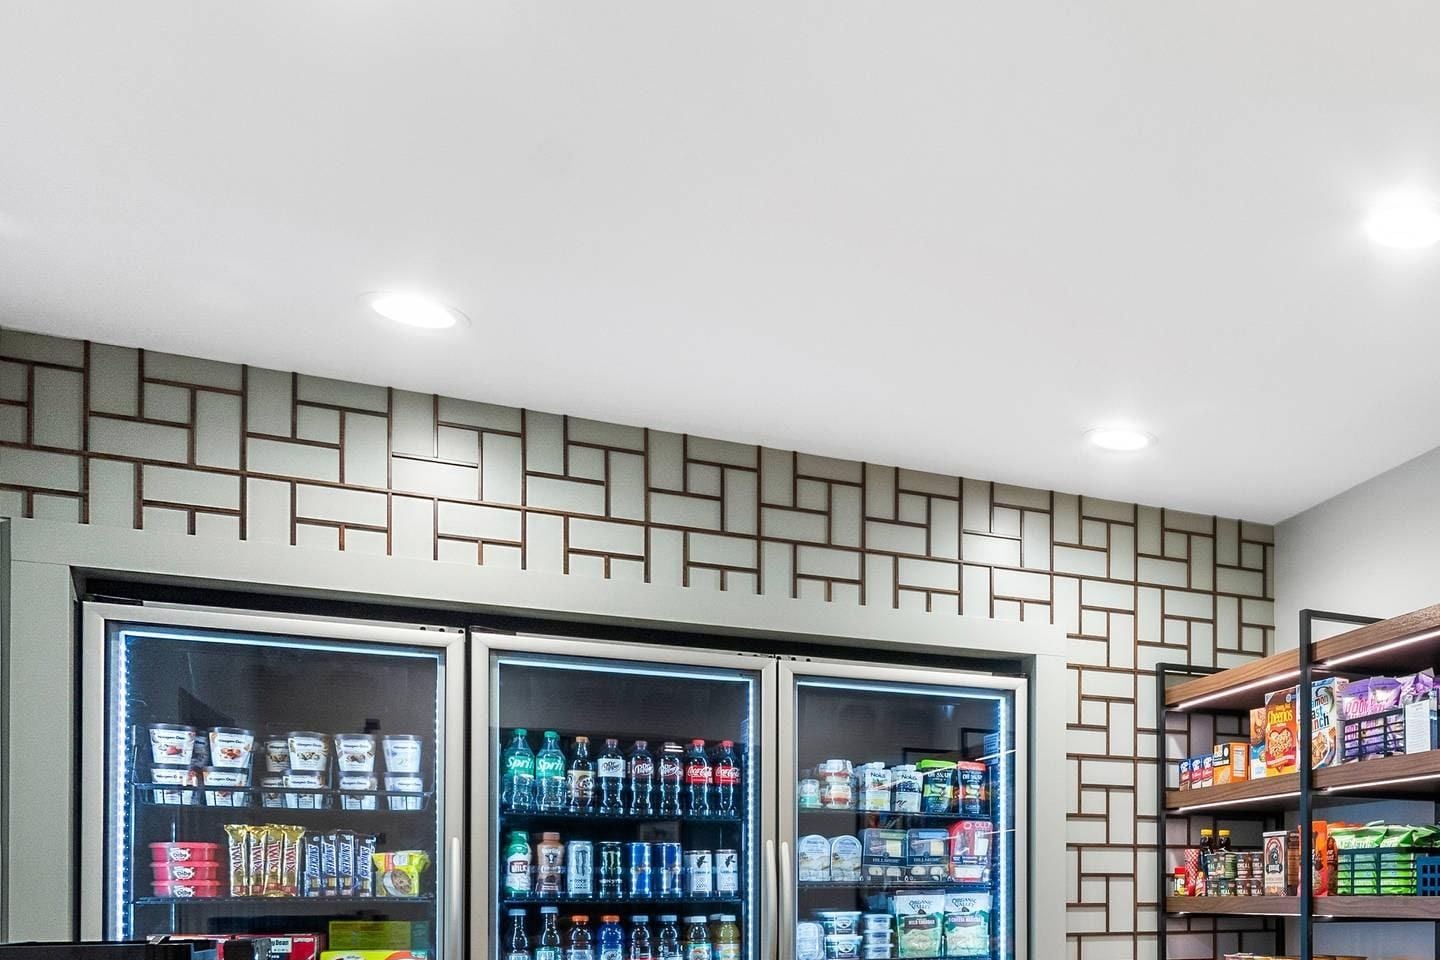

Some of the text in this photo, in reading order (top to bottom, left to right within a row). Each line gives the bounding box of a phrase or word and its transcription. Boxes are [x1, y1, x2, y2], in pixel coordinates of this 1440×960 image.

[1267, 709, 1293, 725] Cheerios
[231, 843, 242, 873] TWIX
[252, 843, 263, 873] TWIX
[269, 843, 281, 869] TWIX
[285, 843, 297, 873] TWIX
